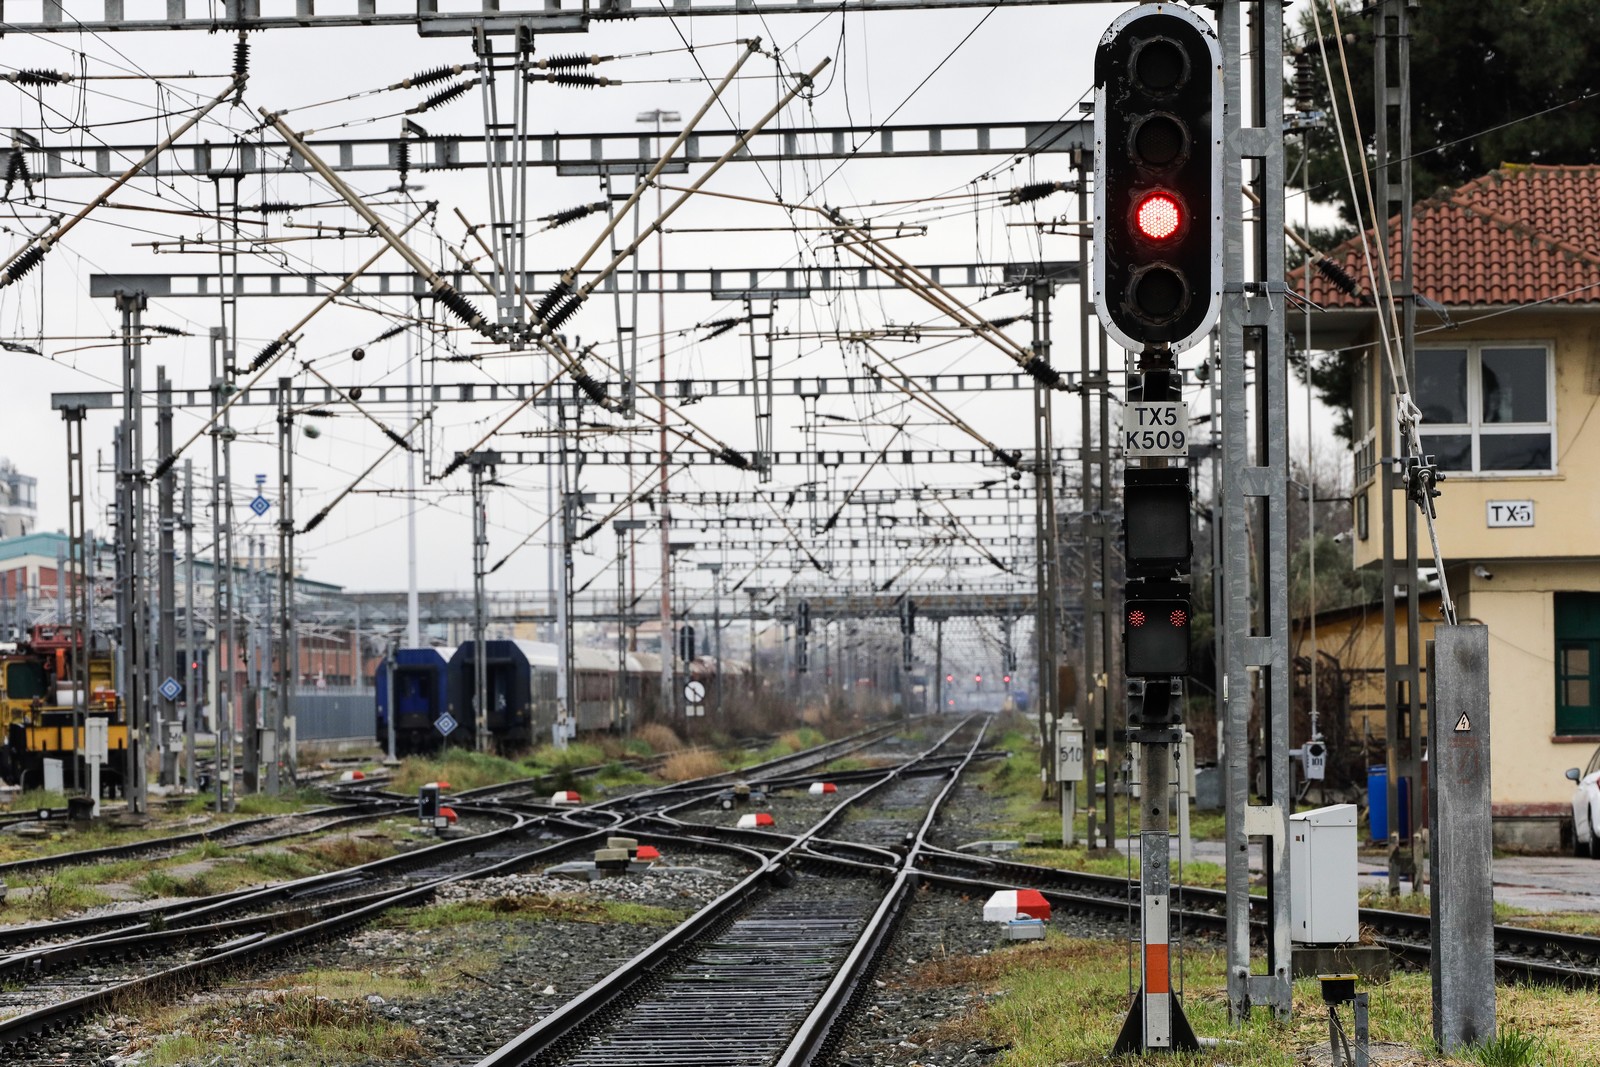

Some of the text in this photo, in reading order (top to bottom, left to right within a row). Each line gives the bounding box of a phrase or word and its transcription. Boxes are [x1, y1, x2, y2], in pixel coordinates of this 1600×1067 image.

[1135, 408, 1177, 426] TX5
[1126, 431, 1185, 449] K509
[1060, 746, 1083, 762] 510
[1311, 757, 1323, 766] 101
